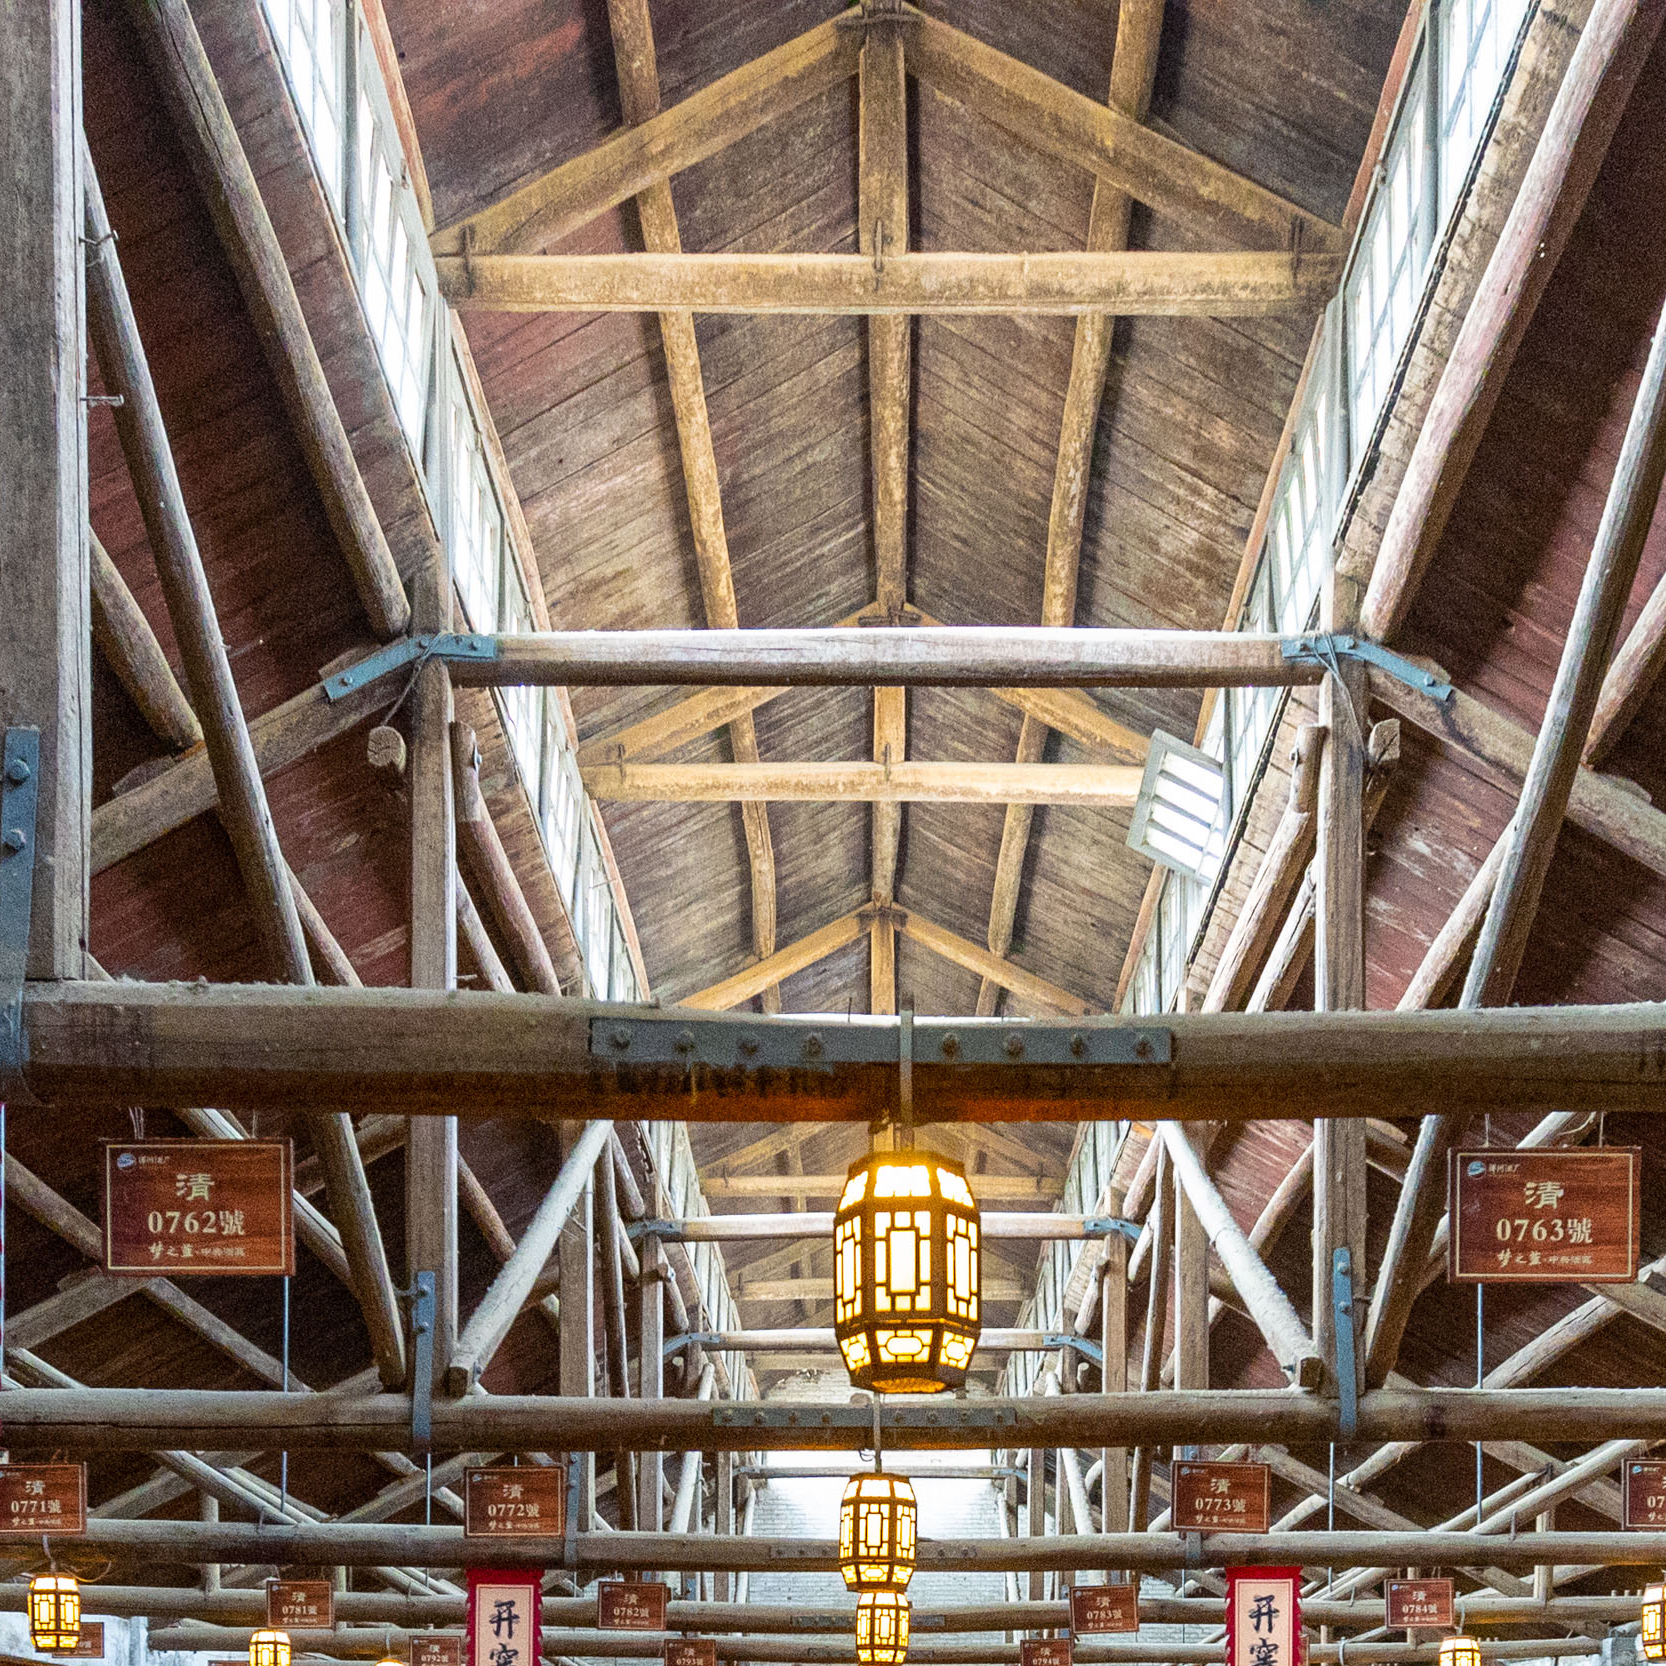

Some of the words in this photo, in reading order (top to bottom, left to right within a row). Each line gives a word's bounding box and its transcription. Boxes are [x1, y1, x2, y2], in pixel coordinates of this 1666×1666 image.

[175, 1172, 215, 1201] 清
[1523, 1181, 1564, 1209] 清
[147, 1209, 245, 1236] 0762號
[1496, 1218, 1593, 1244] 0763號
[10, 1499, 62, 1513] 0771號
[487, 1503, 540, 1517] 0772號
[1195, 1497, 1246, 1512] 0773號
